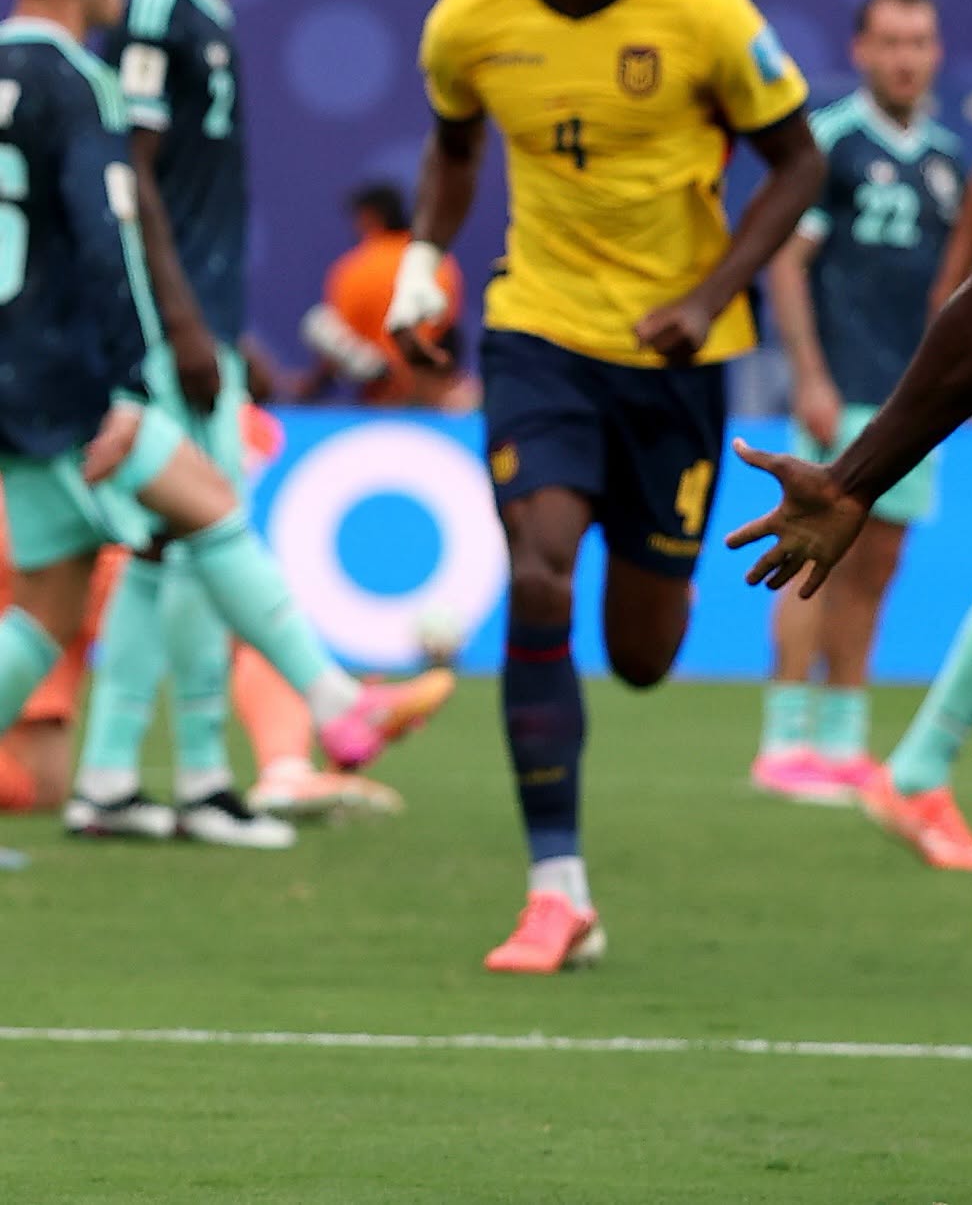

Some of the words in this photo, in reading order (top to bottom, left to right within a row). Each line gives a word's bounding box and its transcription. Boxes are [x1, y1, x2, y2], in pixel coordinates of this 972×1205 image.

[553, 118, 586, 171] 4
[851, 182, 921, 248] 22
[675, 458, 713, 535] 4
